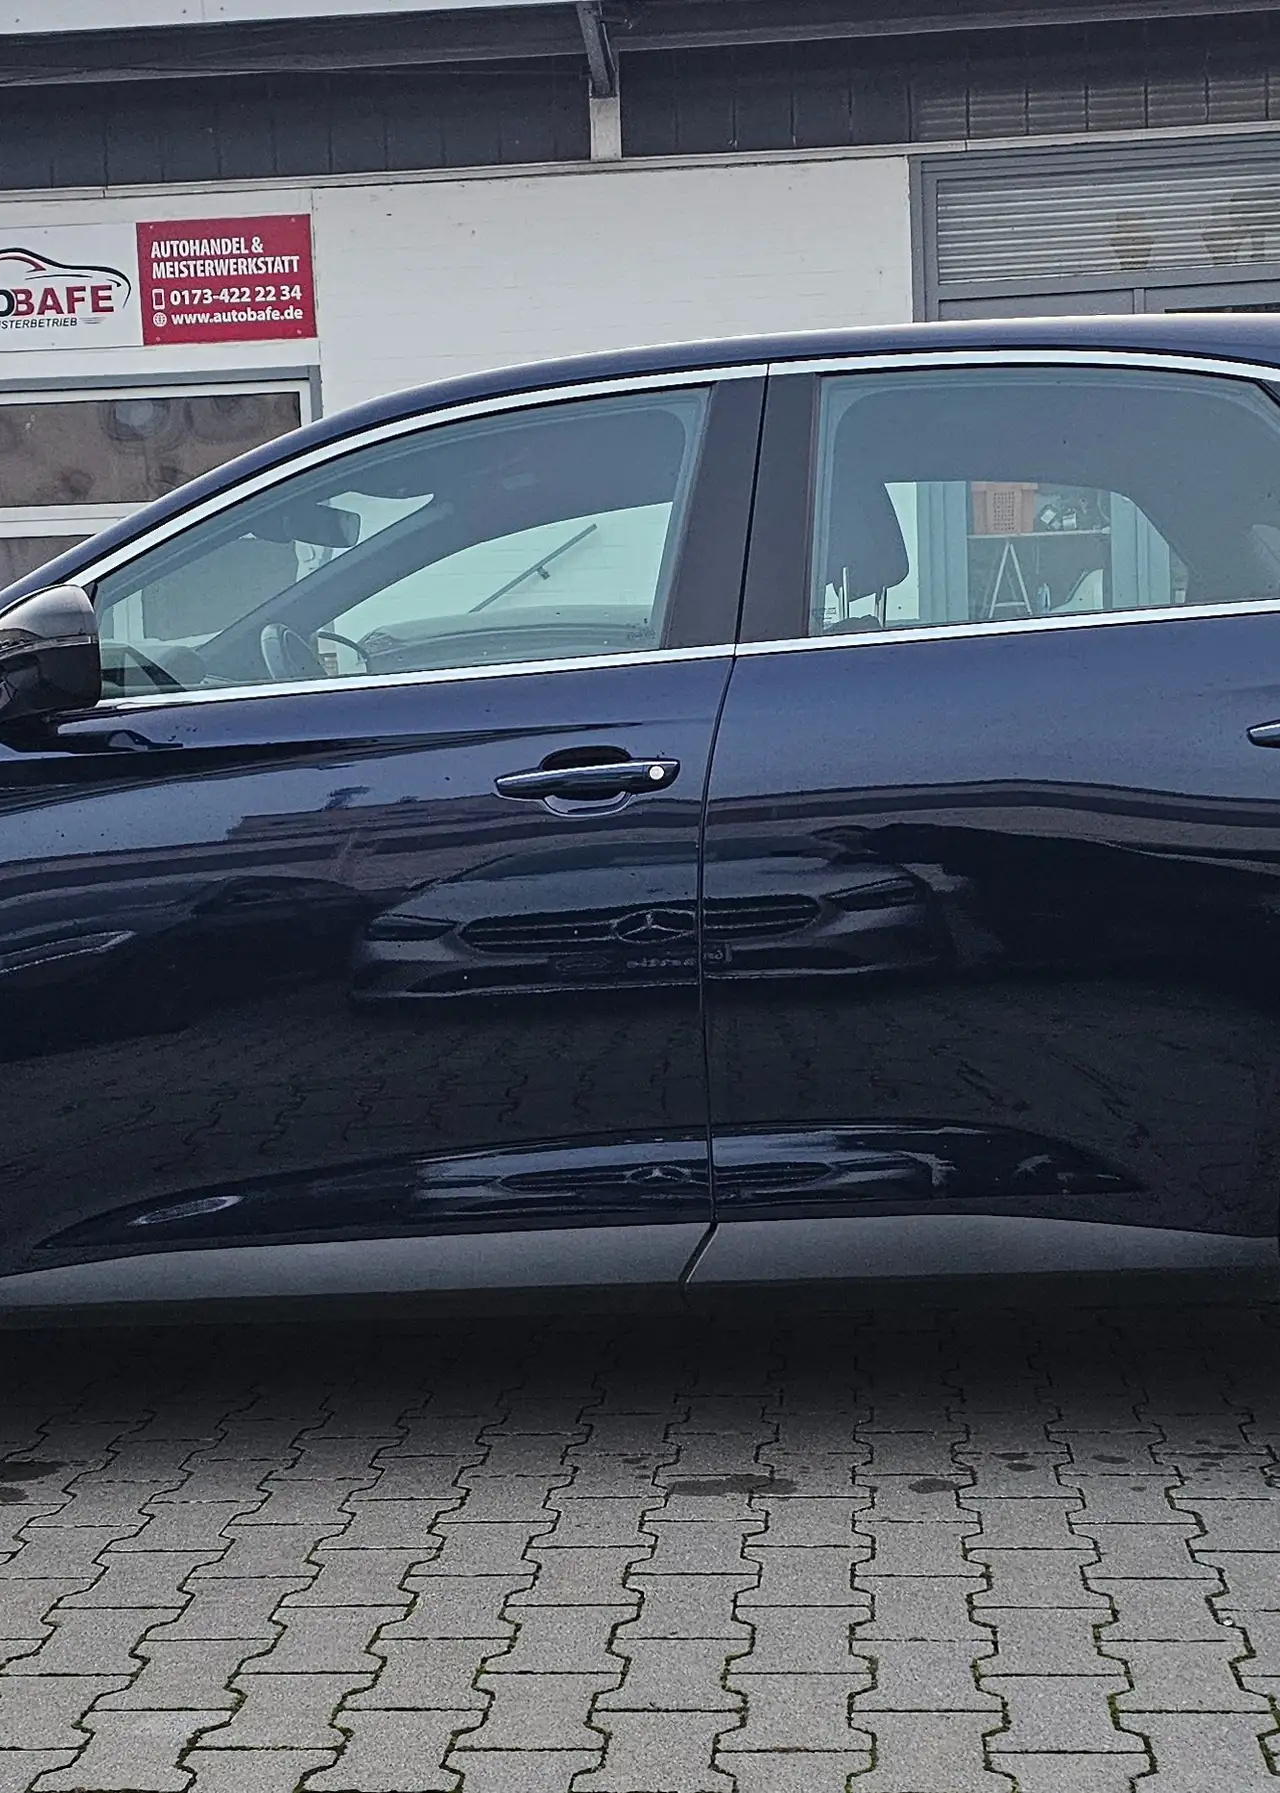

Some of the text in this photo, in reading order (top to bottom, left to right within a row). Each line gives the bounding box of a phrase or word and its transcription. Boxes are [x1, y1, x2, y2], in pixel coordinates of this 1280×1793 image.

[151, 237, 264, 258] AUTOHANDEL &
[152, 256, 300, 279] MEISTERWERKSTATT
[170, 285, 302, 306] 0173-422 22 34
[171, 305, 303, 325] www.autobafe.de
